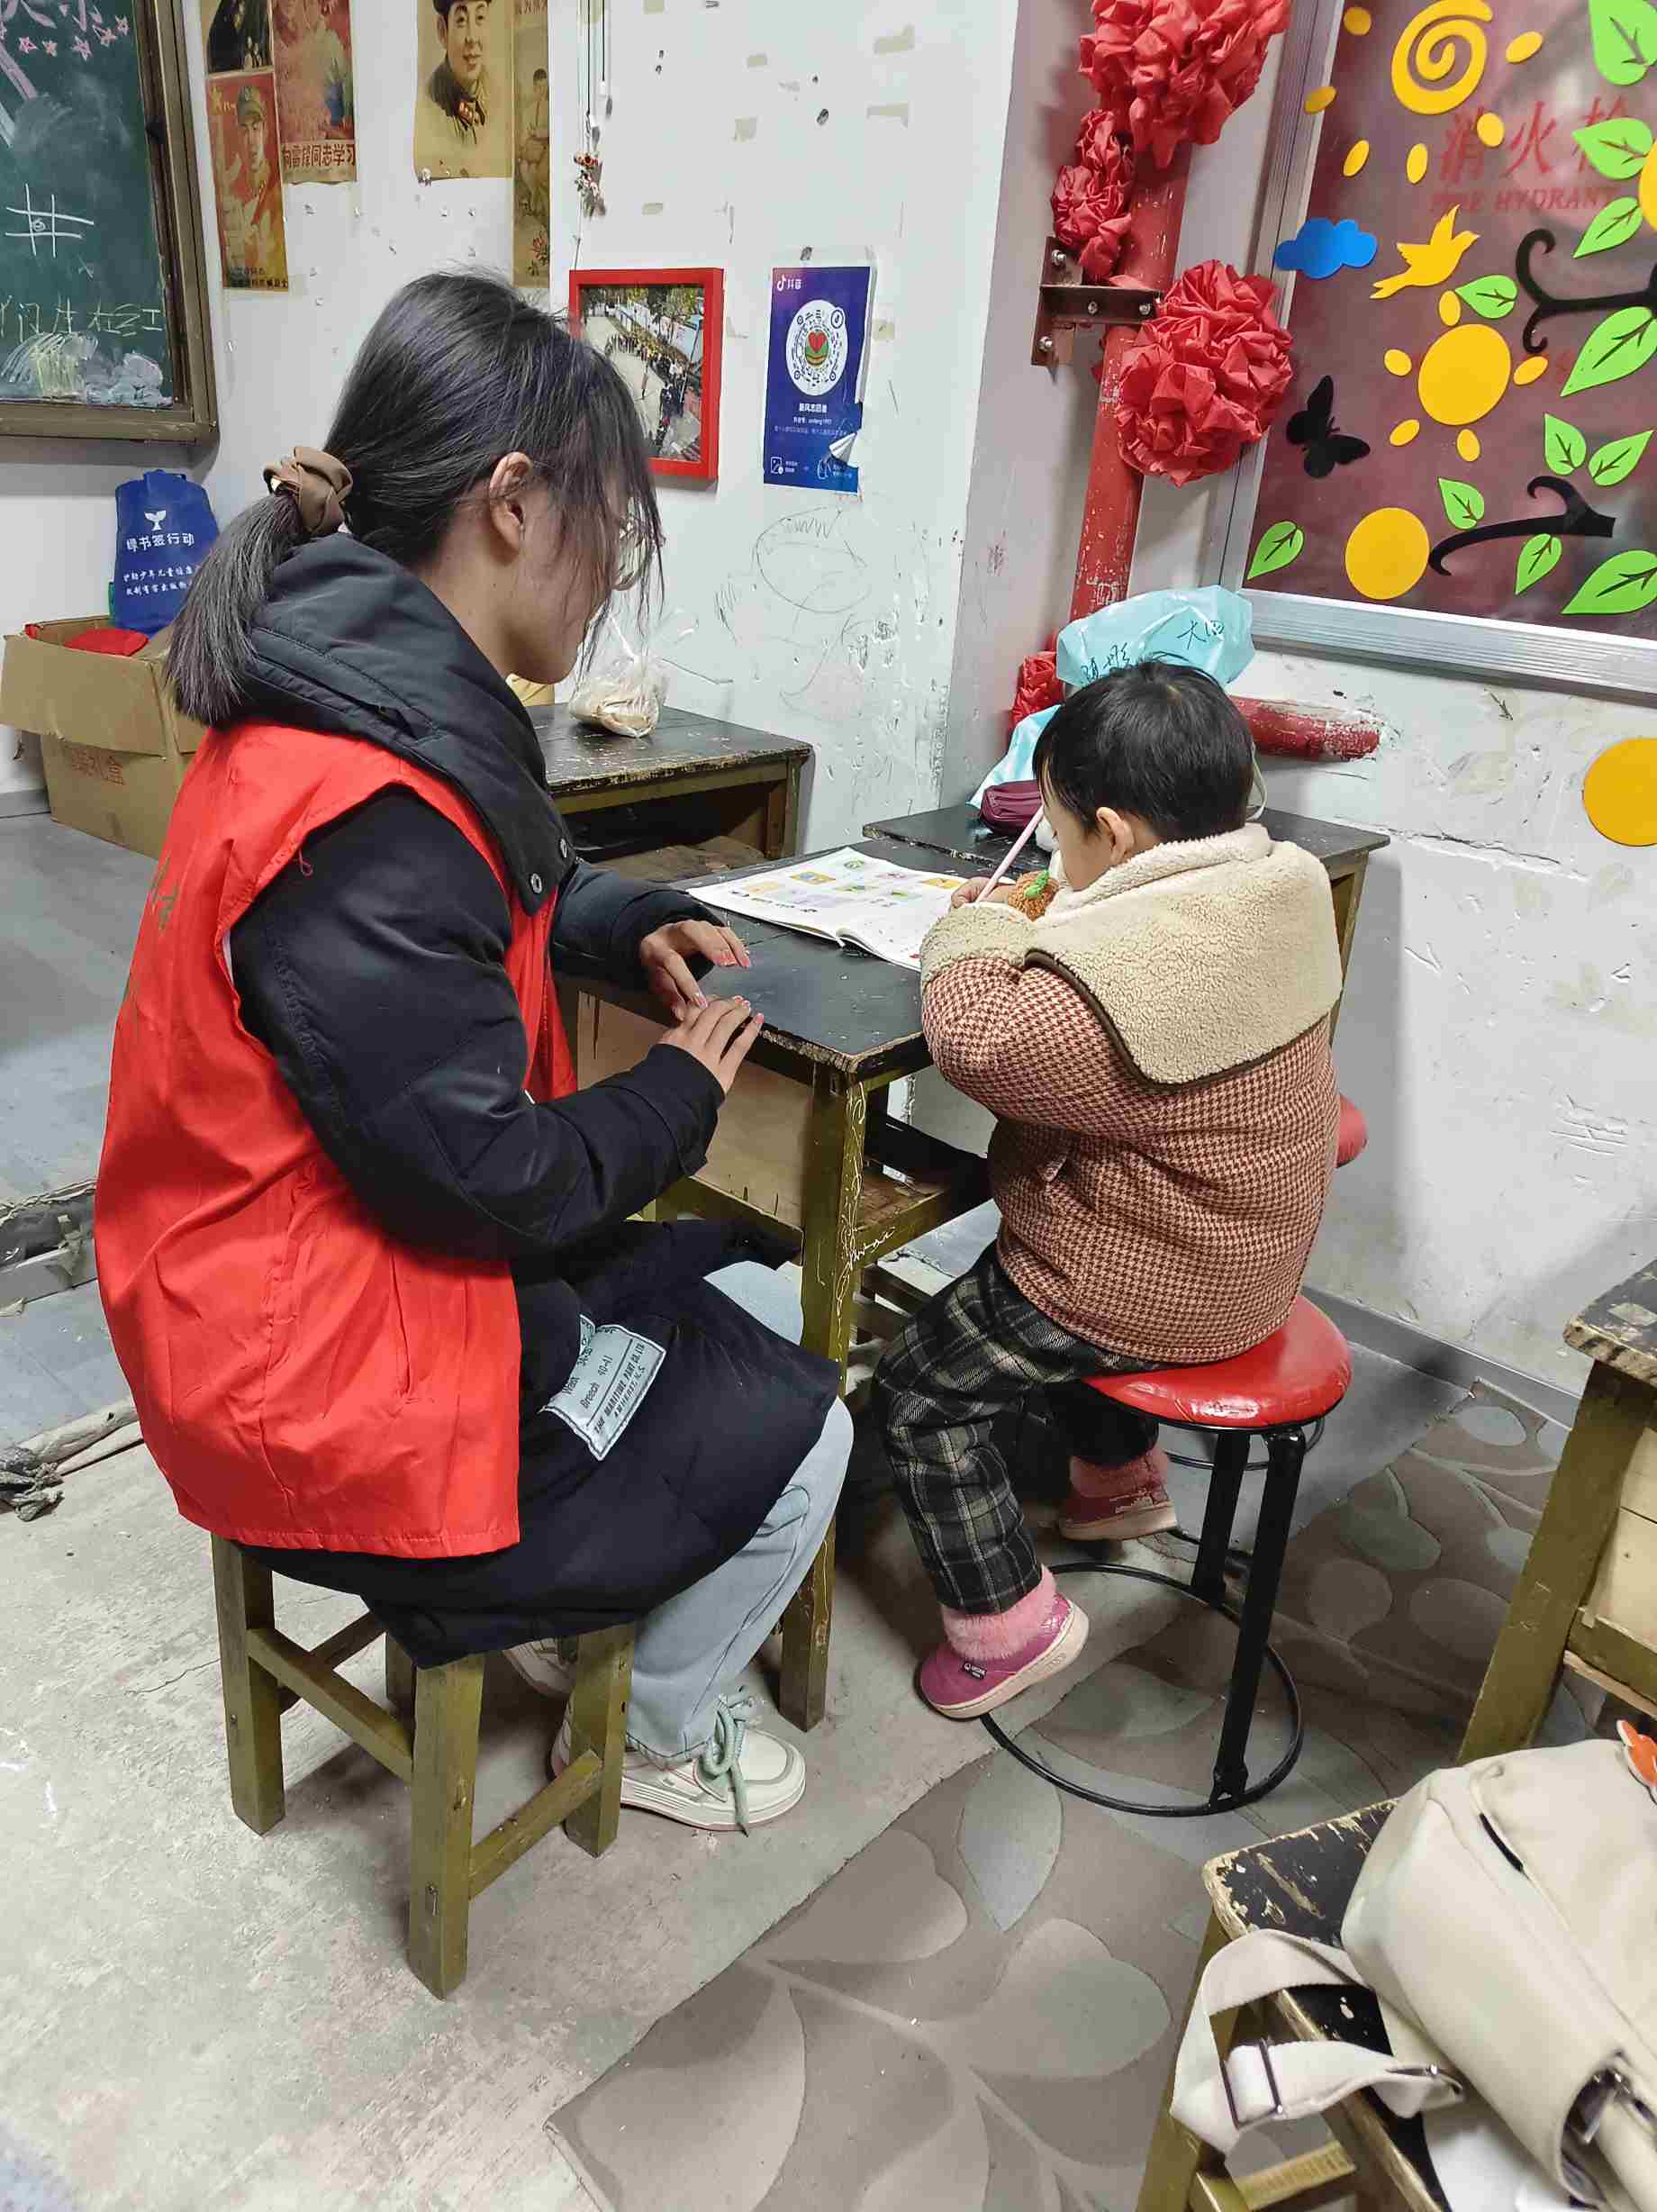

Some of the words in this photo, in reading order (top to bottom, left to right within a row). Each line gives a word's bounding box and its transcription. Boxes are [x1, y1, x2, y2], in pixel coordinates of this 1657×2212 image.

[282, 143, 355, 167] 向雷锋同志学习
[788, 278, 801, 289] 抖音
